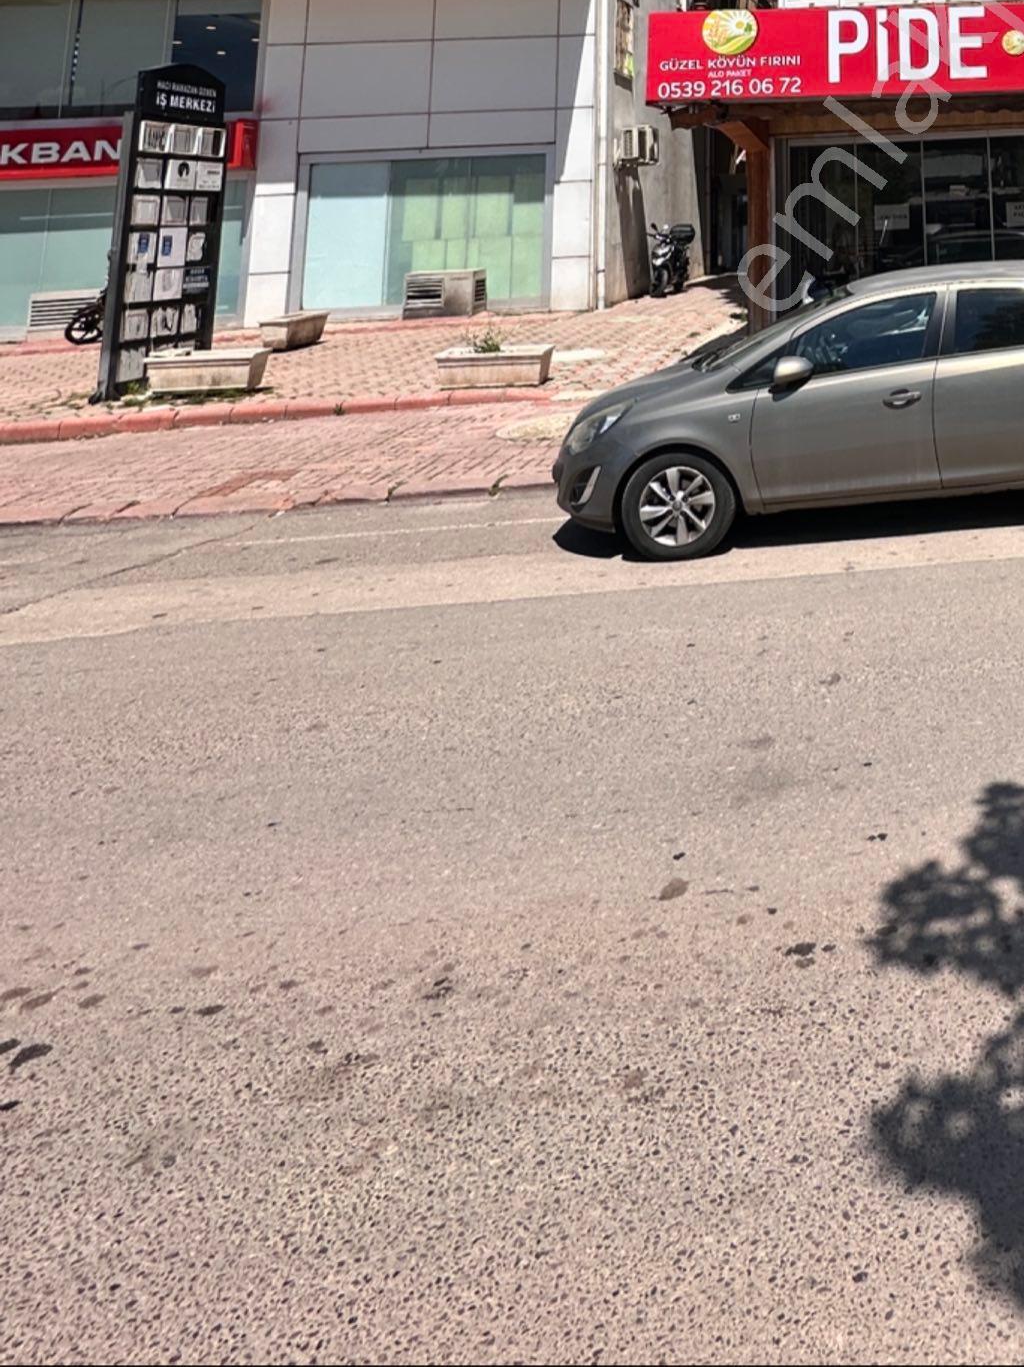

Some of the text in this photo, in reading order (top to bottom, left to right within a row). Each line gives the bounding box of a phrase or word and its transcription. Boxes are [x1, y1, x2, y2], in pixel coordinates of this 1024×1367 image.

[659, 57, 703, 72] GÜZEL
[760, 54, 801, 67] FIRINI
[657, 76, 802, 99] 0539 216 06 72
[156, 92, 216, 114] İŞ MERKEZİ
[0, 139, 121, 166] KBAN
